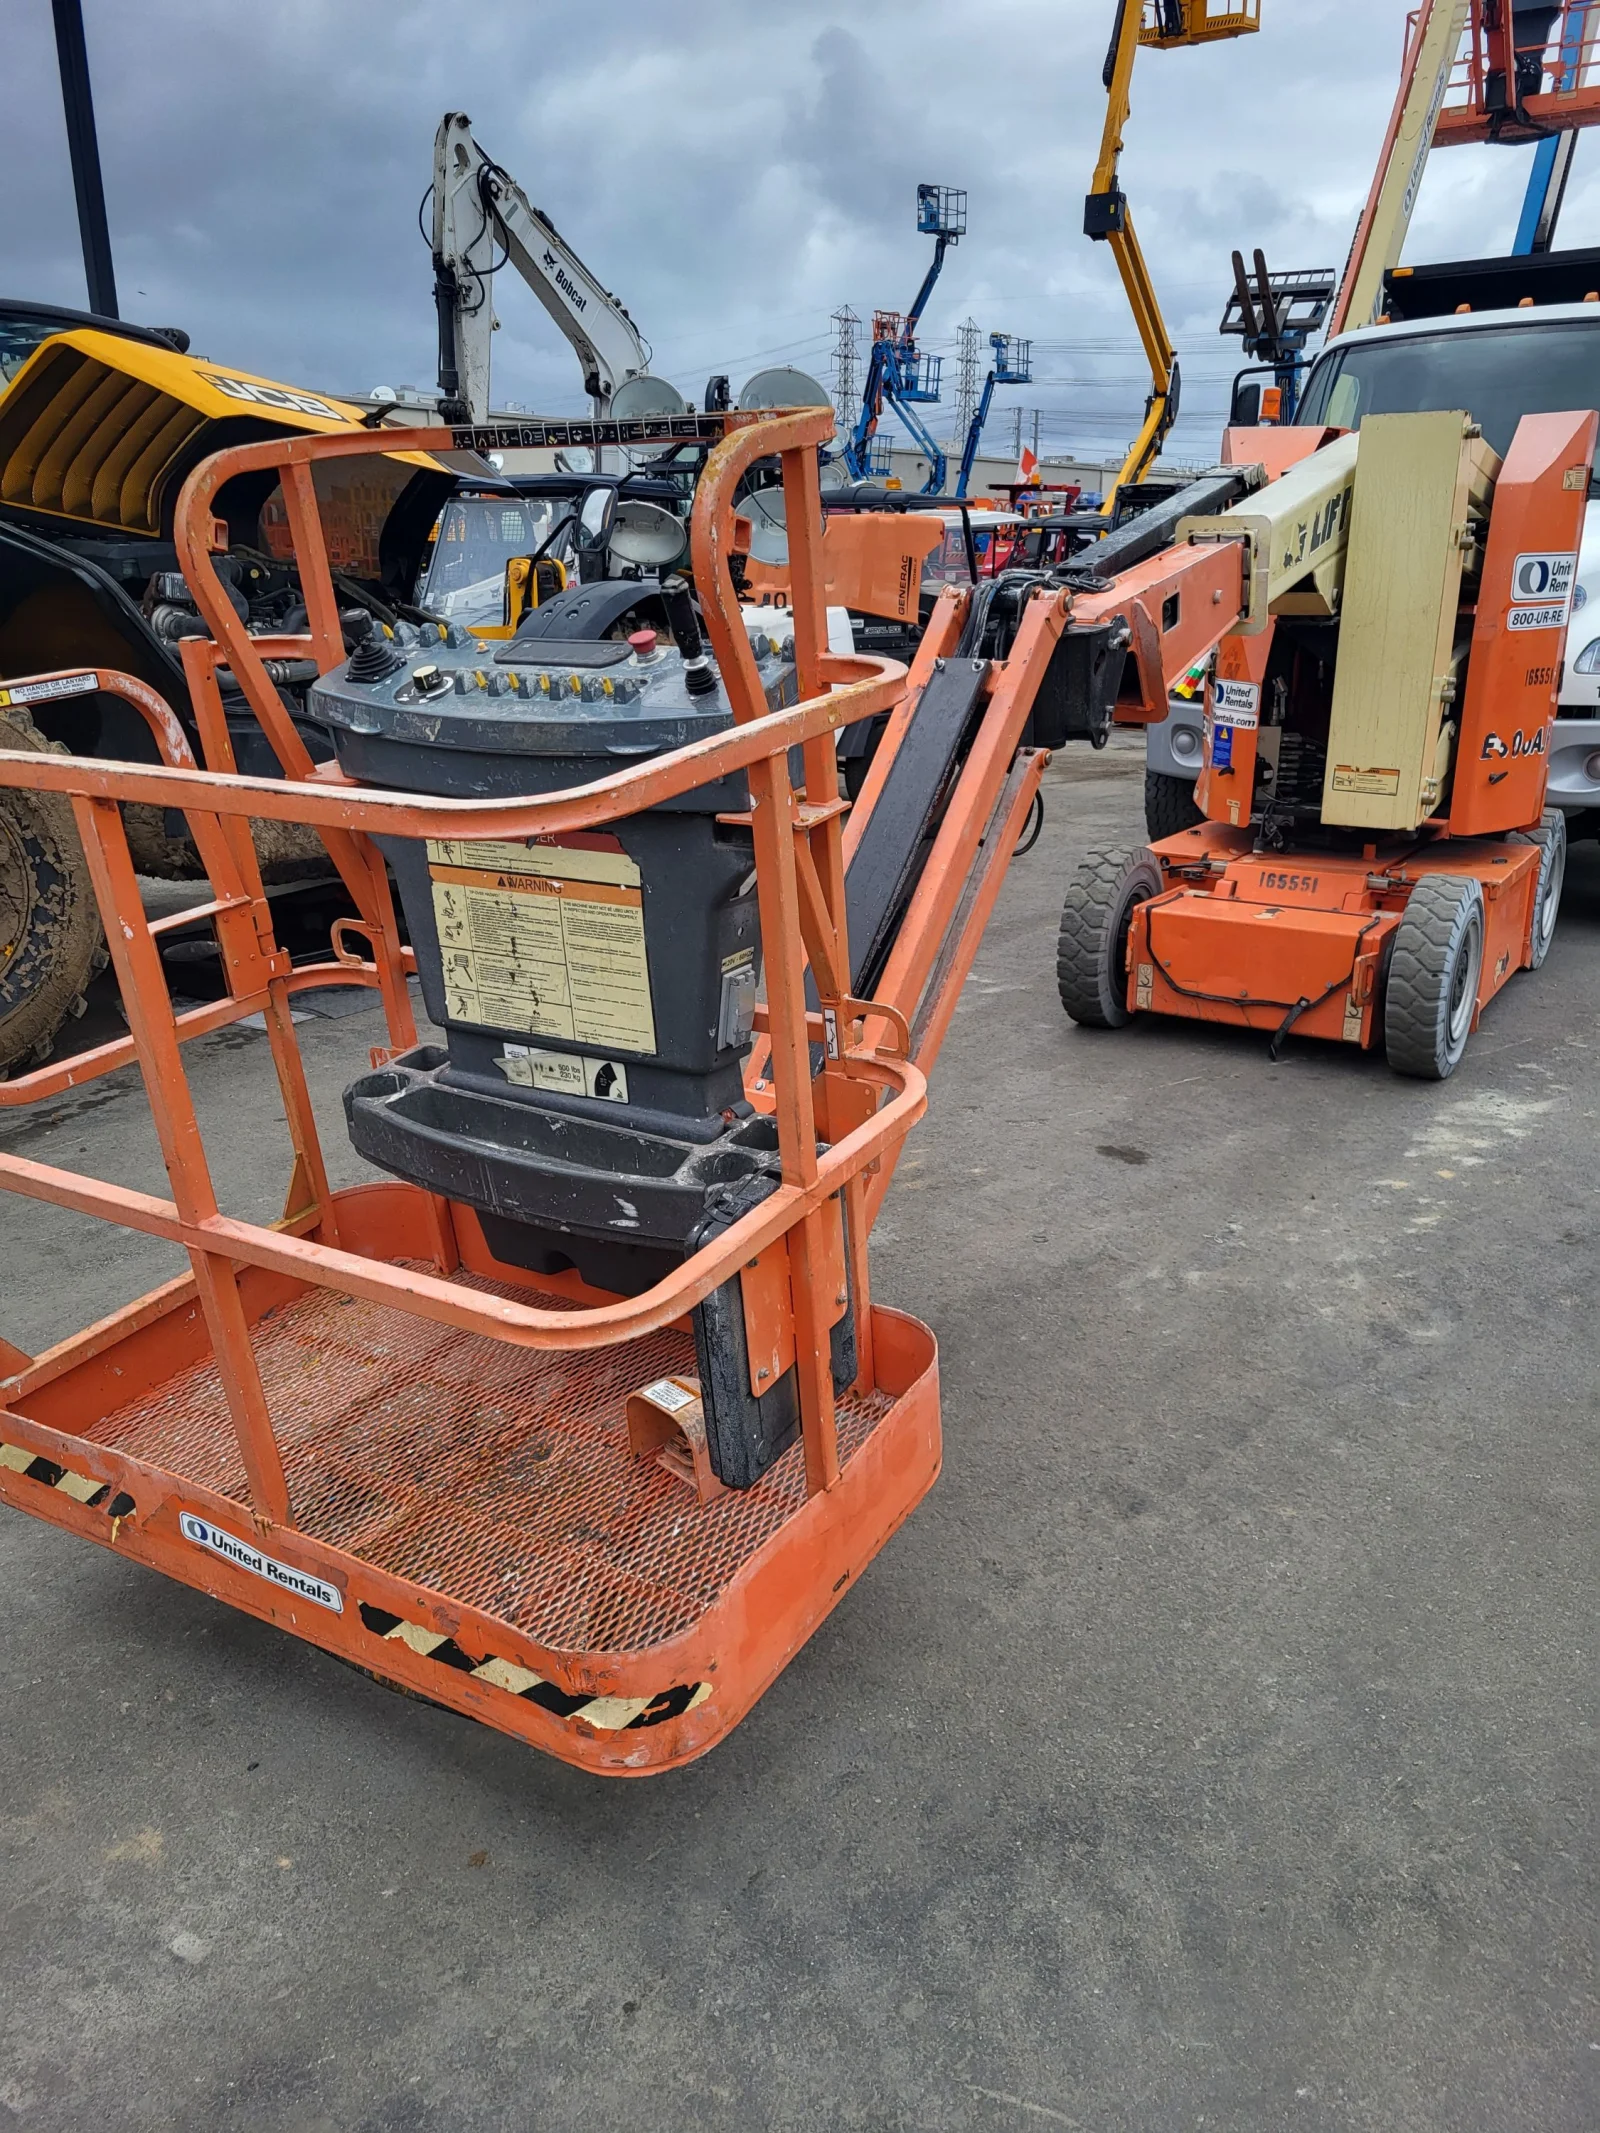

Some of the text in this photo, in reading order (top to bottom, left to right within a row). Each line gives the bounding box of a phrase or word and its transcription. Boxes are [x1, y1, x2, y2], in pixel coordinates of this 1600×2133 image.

[1411, 132, 1428, 188] United
[555, 268, 587, 313] Bobcat
[215, 378, 344, 421] JCB
[1551, 560, 1573, 576] Unit
[898, 555, 909, 615] GENERAC
[27, 683, 49, 692] HANDS
[62, 676, 91, 686] LANYARD
[1226, 685, 1252, 698] United
[1224, 697, 1254, 709] Rentals
[507, 876, 562, 894] WARNING
[1259, 871, 1319, 894] 165551
[558, 1064, 569, 1072] 500
[560, 1072, 571, 1080] 230
[573, 1074, 580, 1082] kg
[212, 1531, 331, 1603] United Rentals
